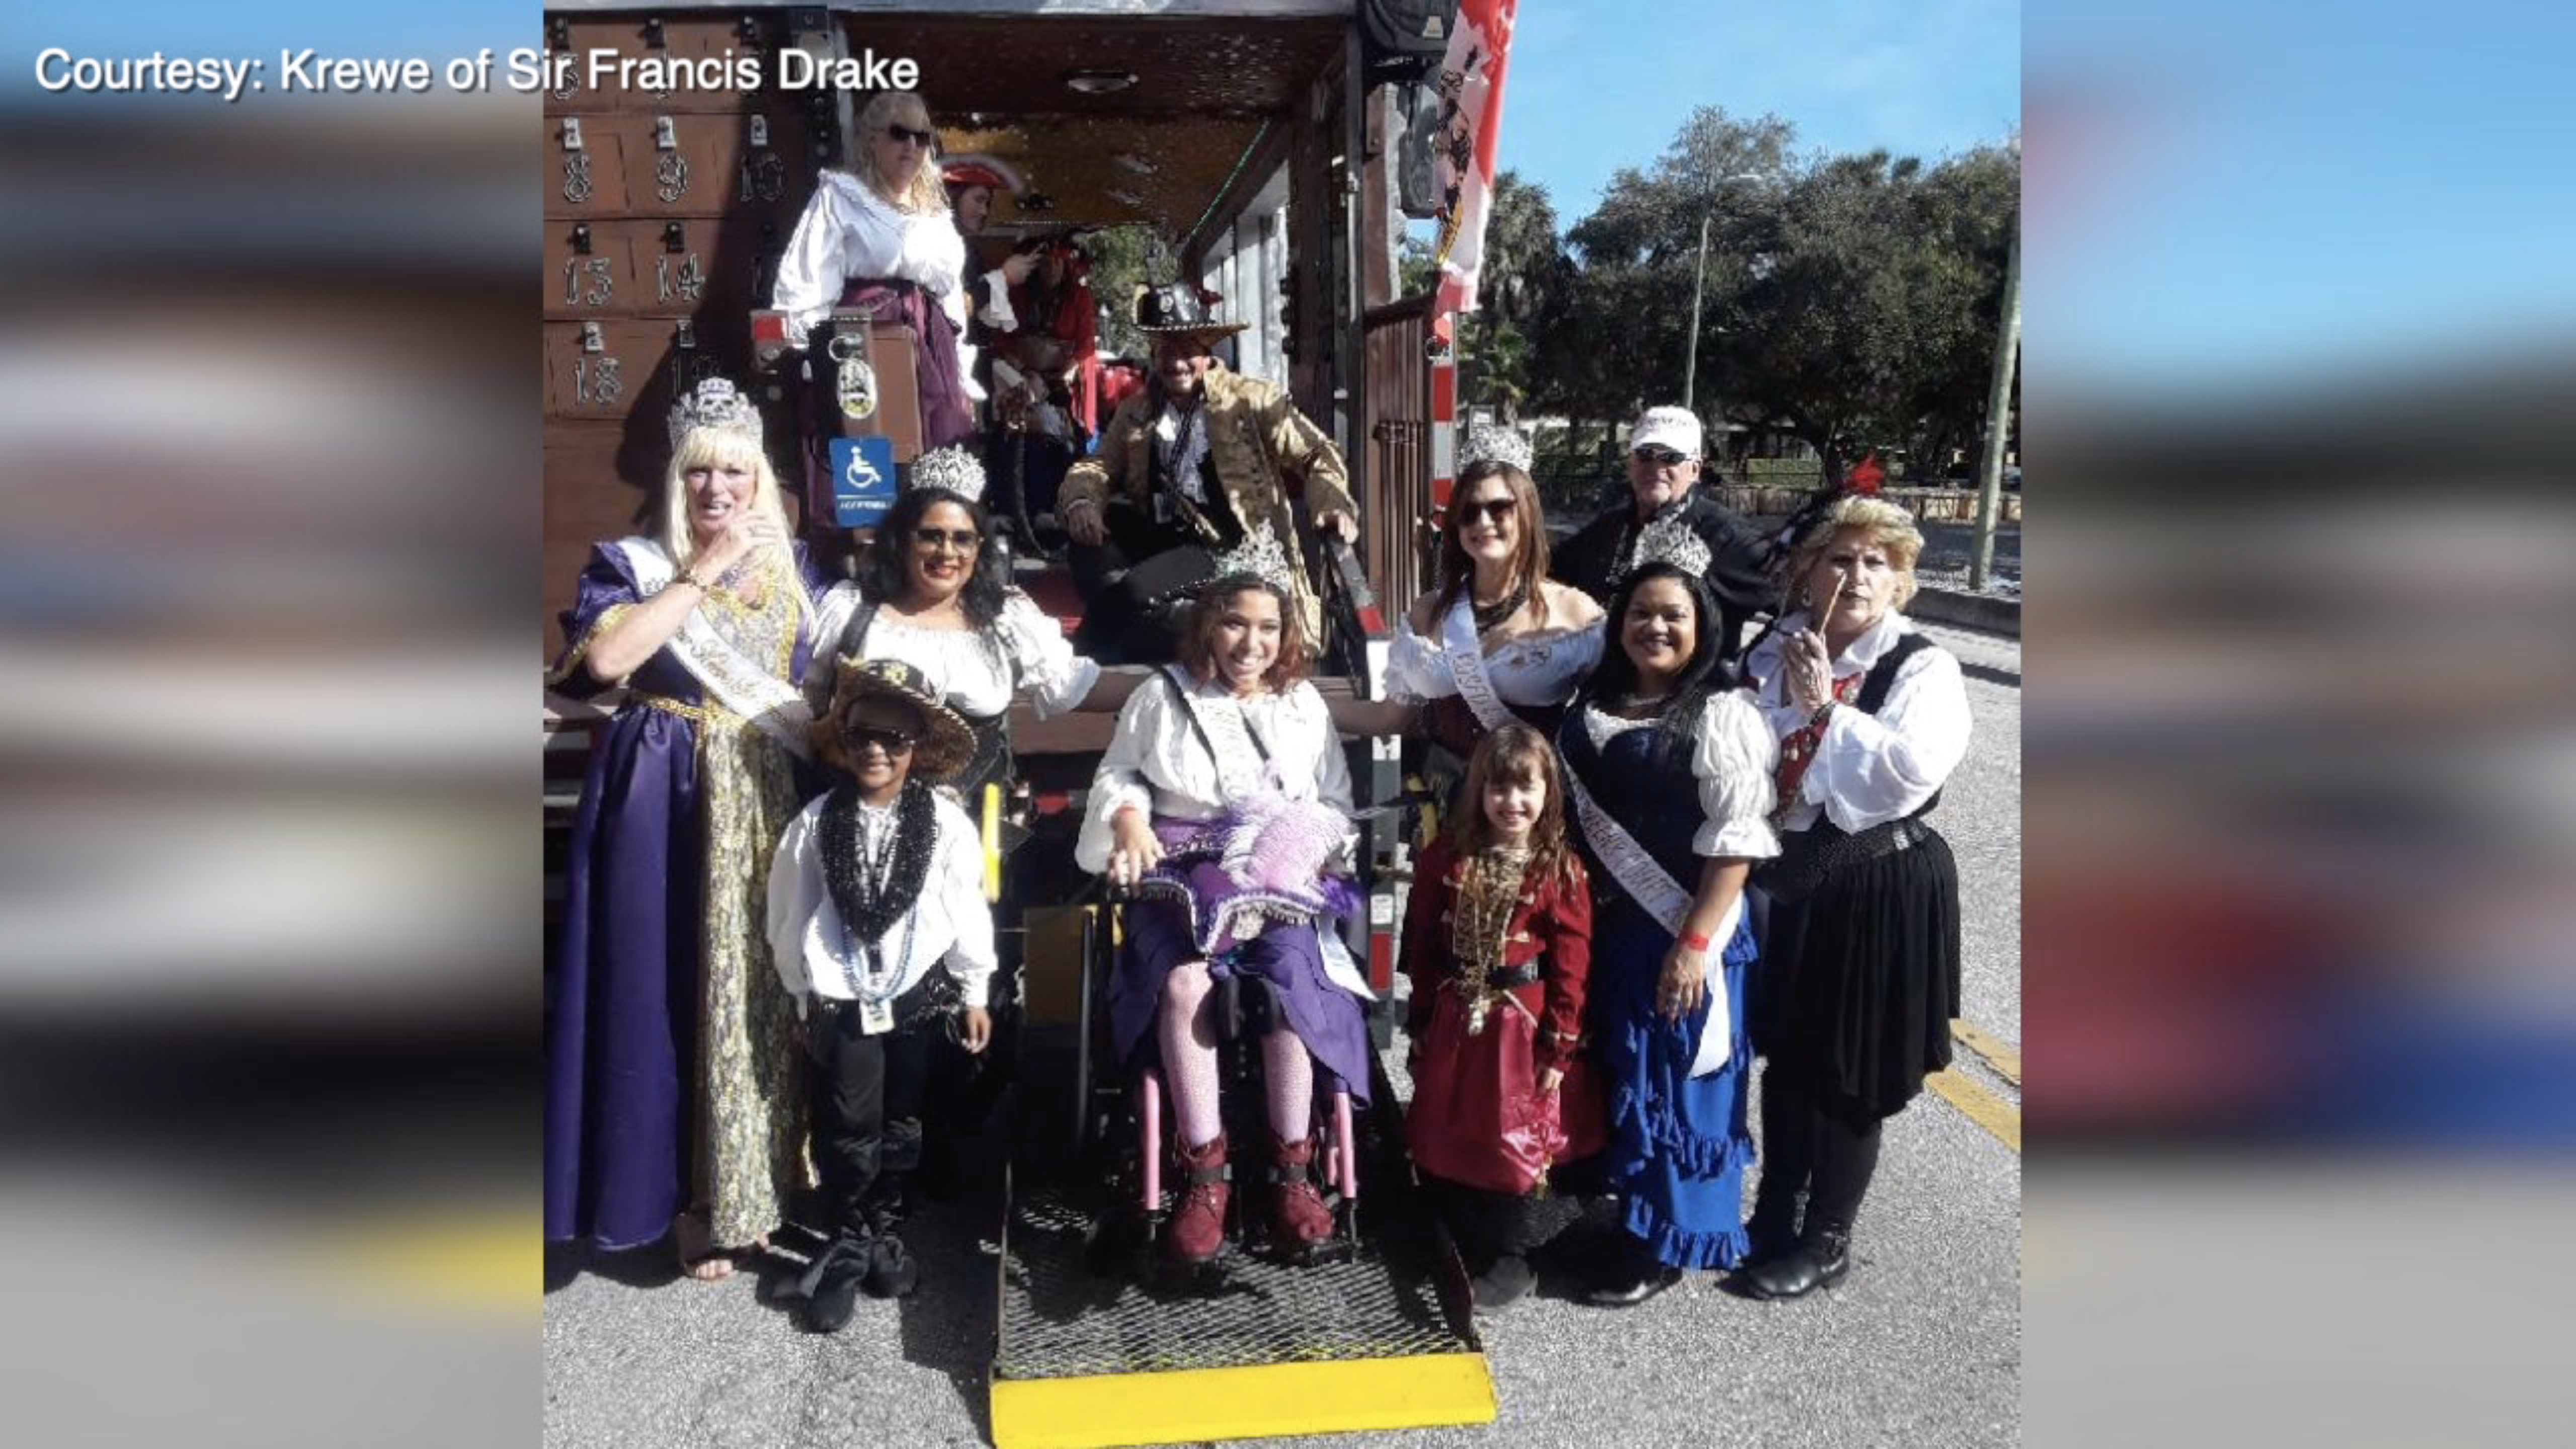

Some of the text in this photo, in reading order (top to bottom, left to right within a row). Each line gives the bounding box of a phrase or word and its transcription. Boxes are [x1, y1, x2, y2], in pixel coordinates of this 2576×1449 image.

[564, 153, 592, 202] 8
[657, 154, 688, 202] 9
[564, 257, 613, 305] 13
[656, 253, 705, 303] 14
[575, 357, 623, 404] 18
